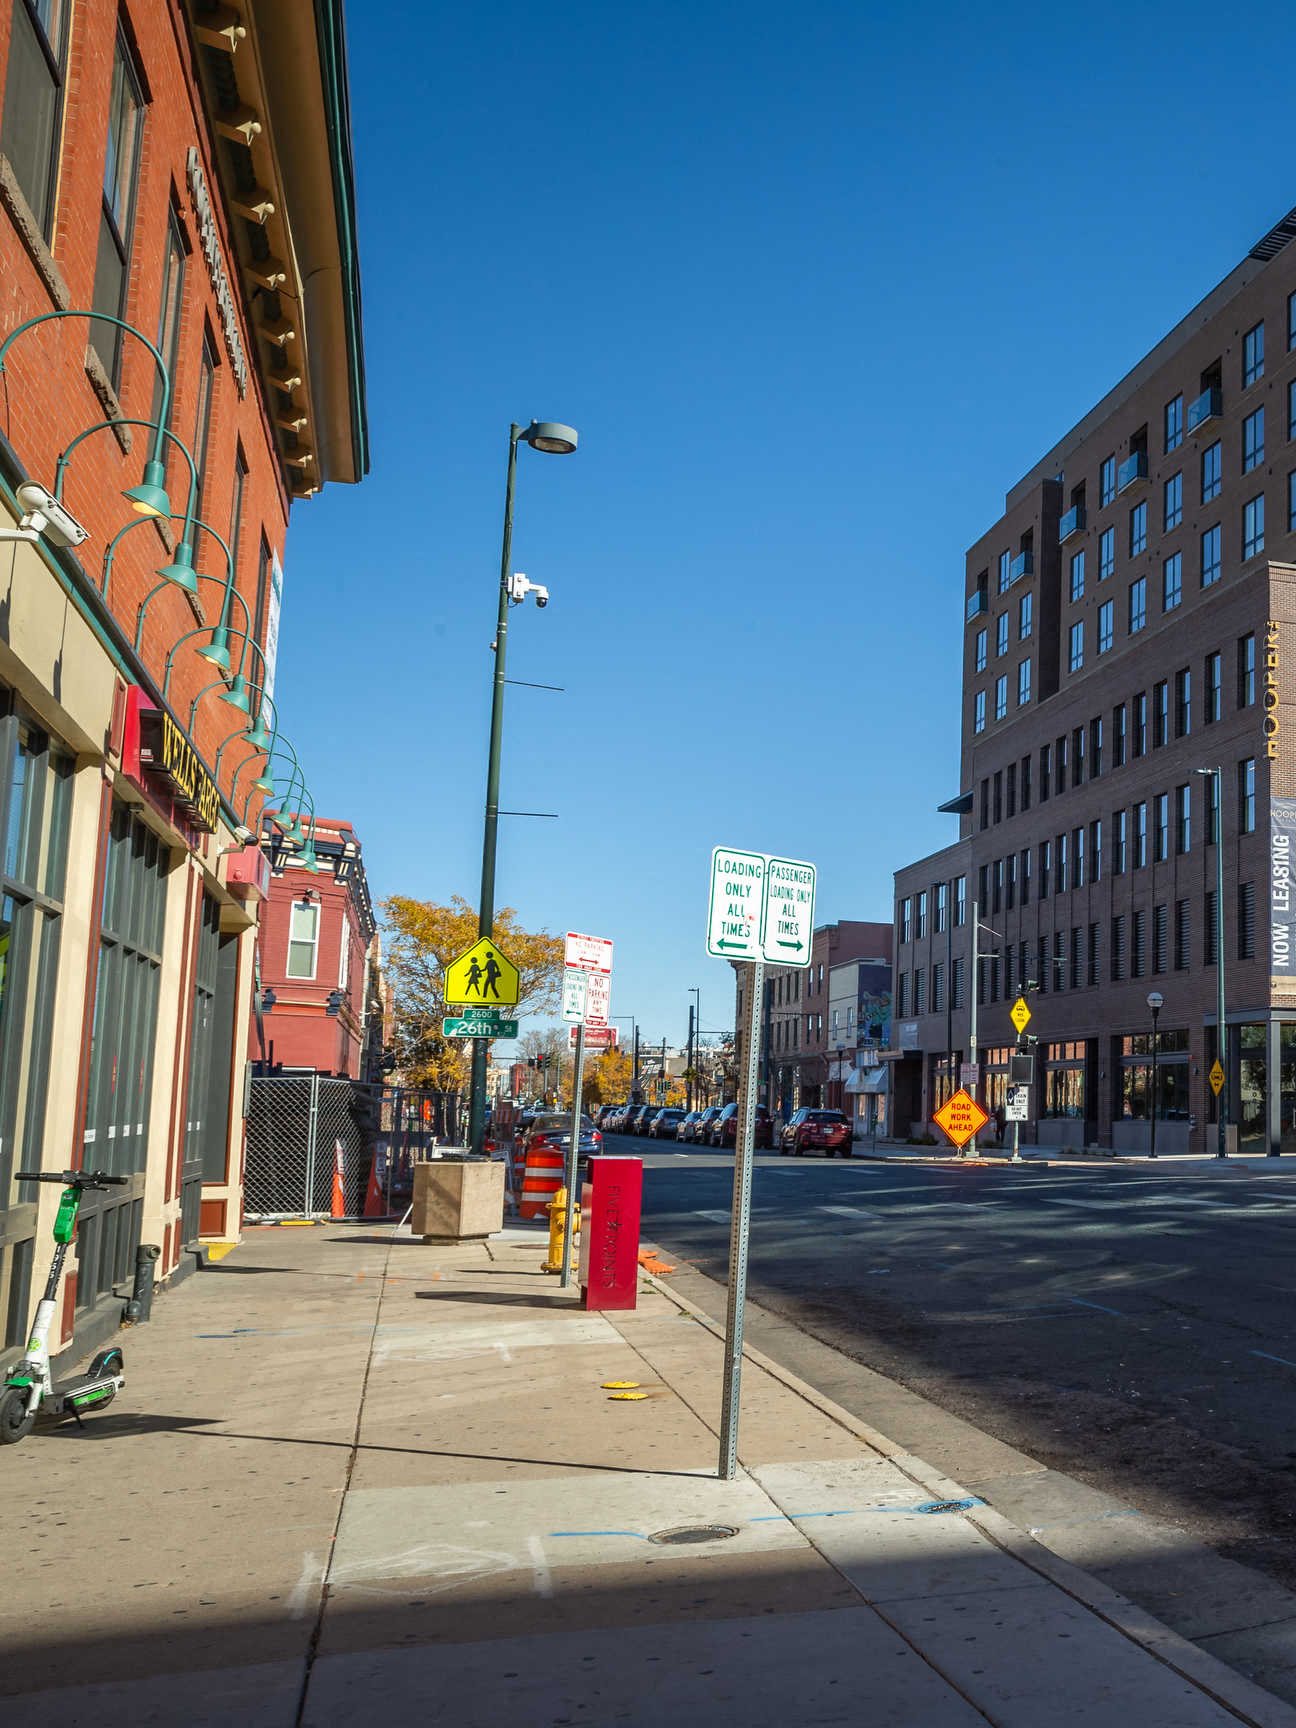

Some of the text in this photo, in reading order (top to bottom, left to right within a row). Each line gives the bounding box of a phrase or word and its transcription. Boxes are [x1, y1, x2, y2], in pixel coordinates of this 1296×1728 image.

[163, 712, 198, 799] WELLS
[718, 858, 762, 879] LOADING
[771, 865, 812, 885] PASSENGER
[1273, 835, 1289, 911] LEASING
[725, 882, 752, 898] ONLY
[770, 885, 811, 904] LOADING ONLY
[727, 903, 745, 918] ALL
[782, 903, 796, 918] ALL
[721, 921, 751, 938] TIMES
[778, 920, 799, 936] TIMES
[1273, 923, 1289, 967] NOW
[458, 1021, 492, 1035] 26th
[951, 1102, 972, 1111] ROAD
[950, 1113, 972, 1121] WORK
[948, 1123, 973, 1132] AHEAD
